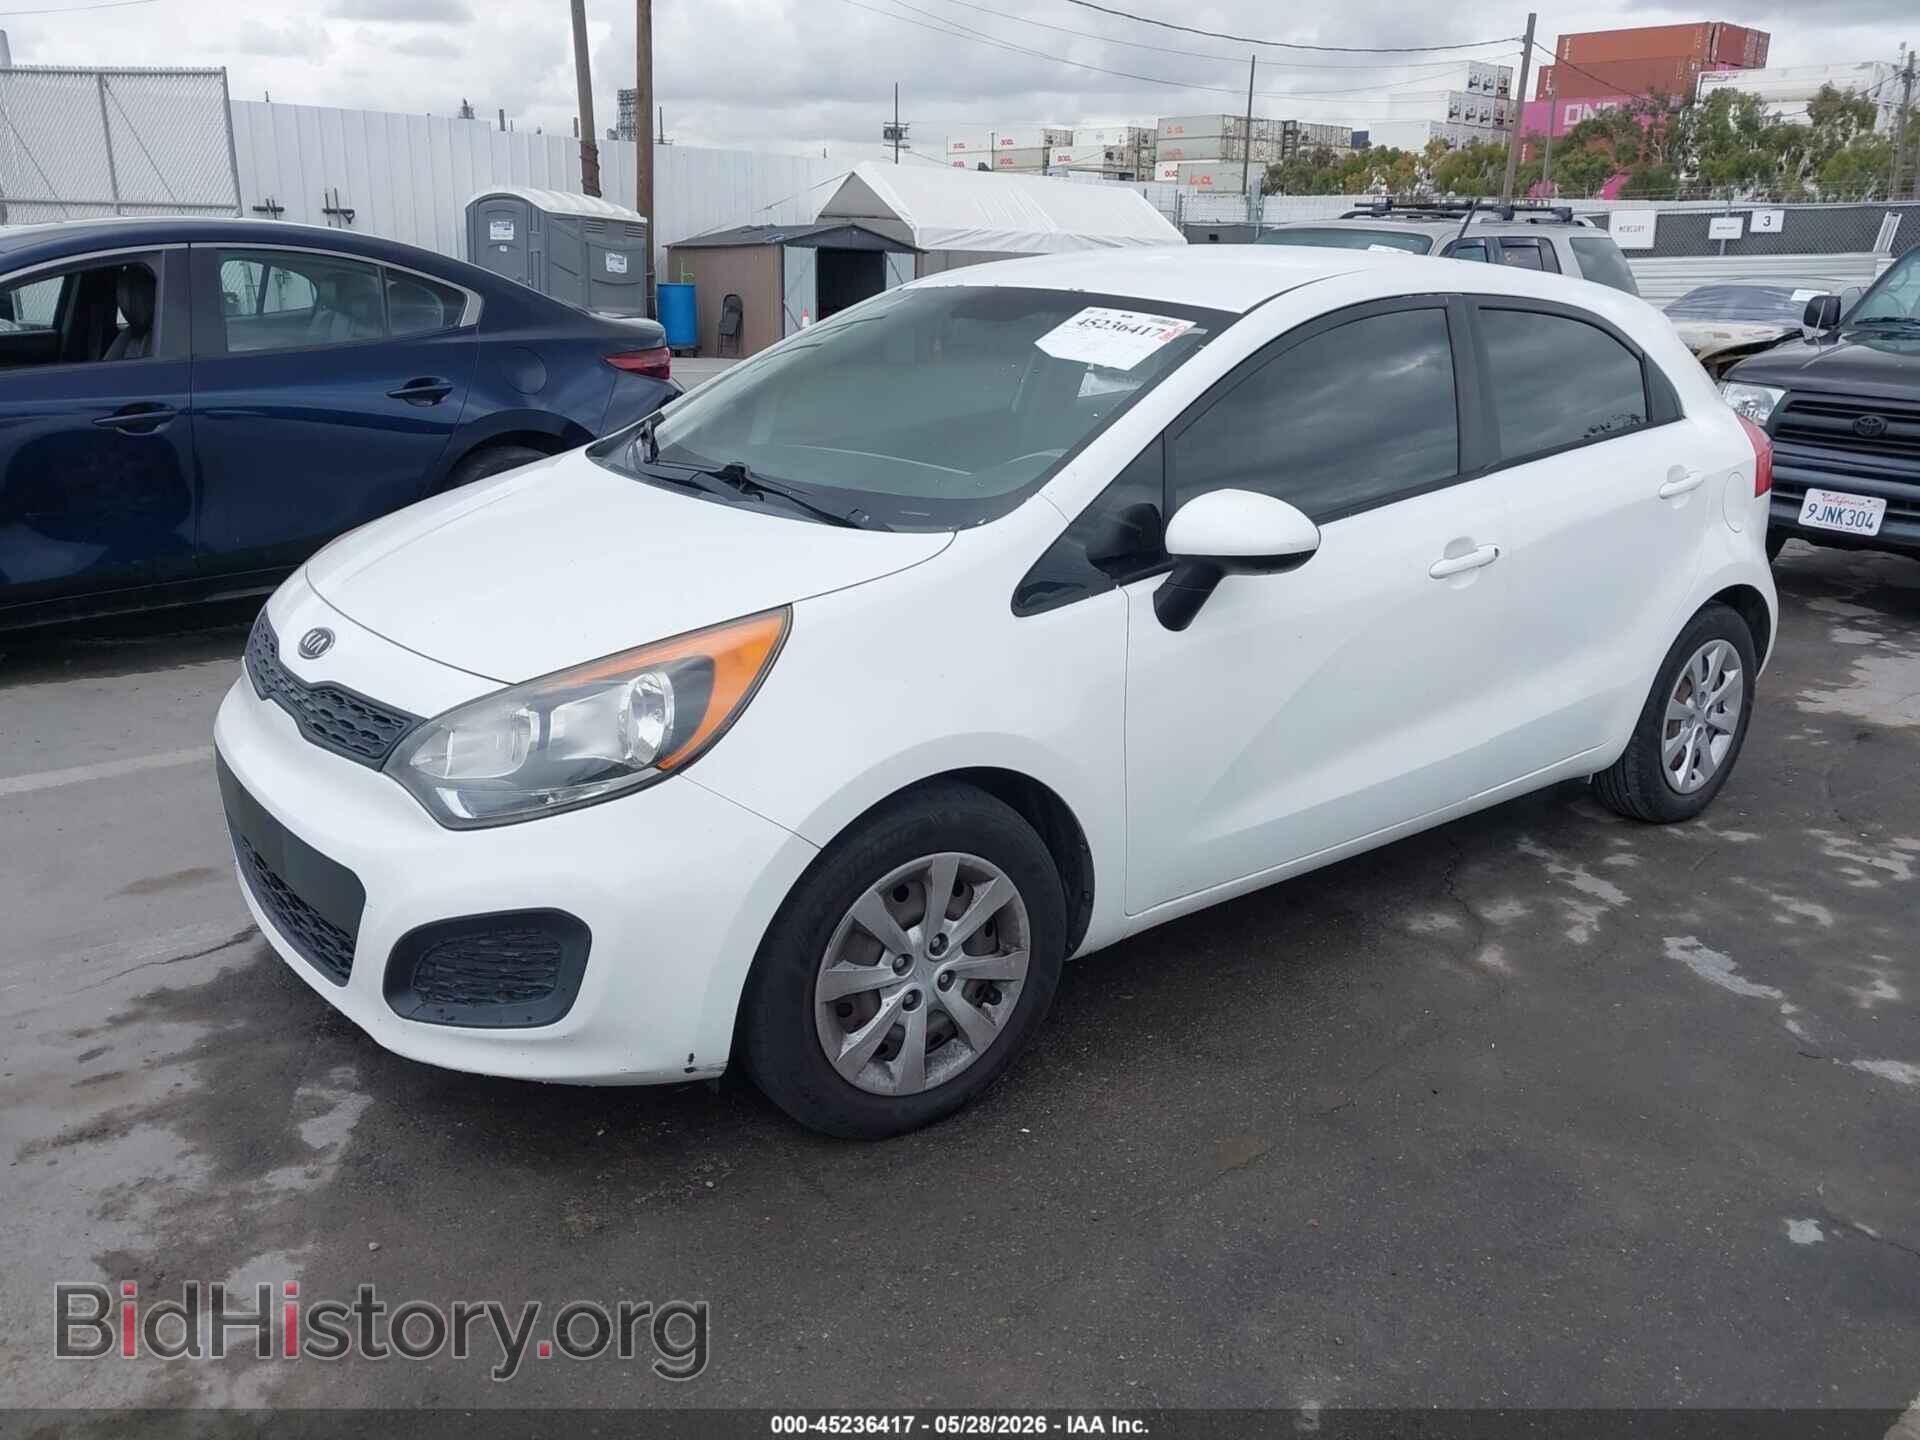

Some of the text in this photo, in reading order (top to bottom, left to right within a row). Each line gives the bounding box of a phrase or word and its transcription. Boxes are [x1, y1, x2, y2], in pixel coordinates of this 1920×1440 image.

[1763, 215, 1772, 227] 3
[1077, 318, 1167, 337] 45236417
[1805, 503, 1874, 530] 9JNK304
